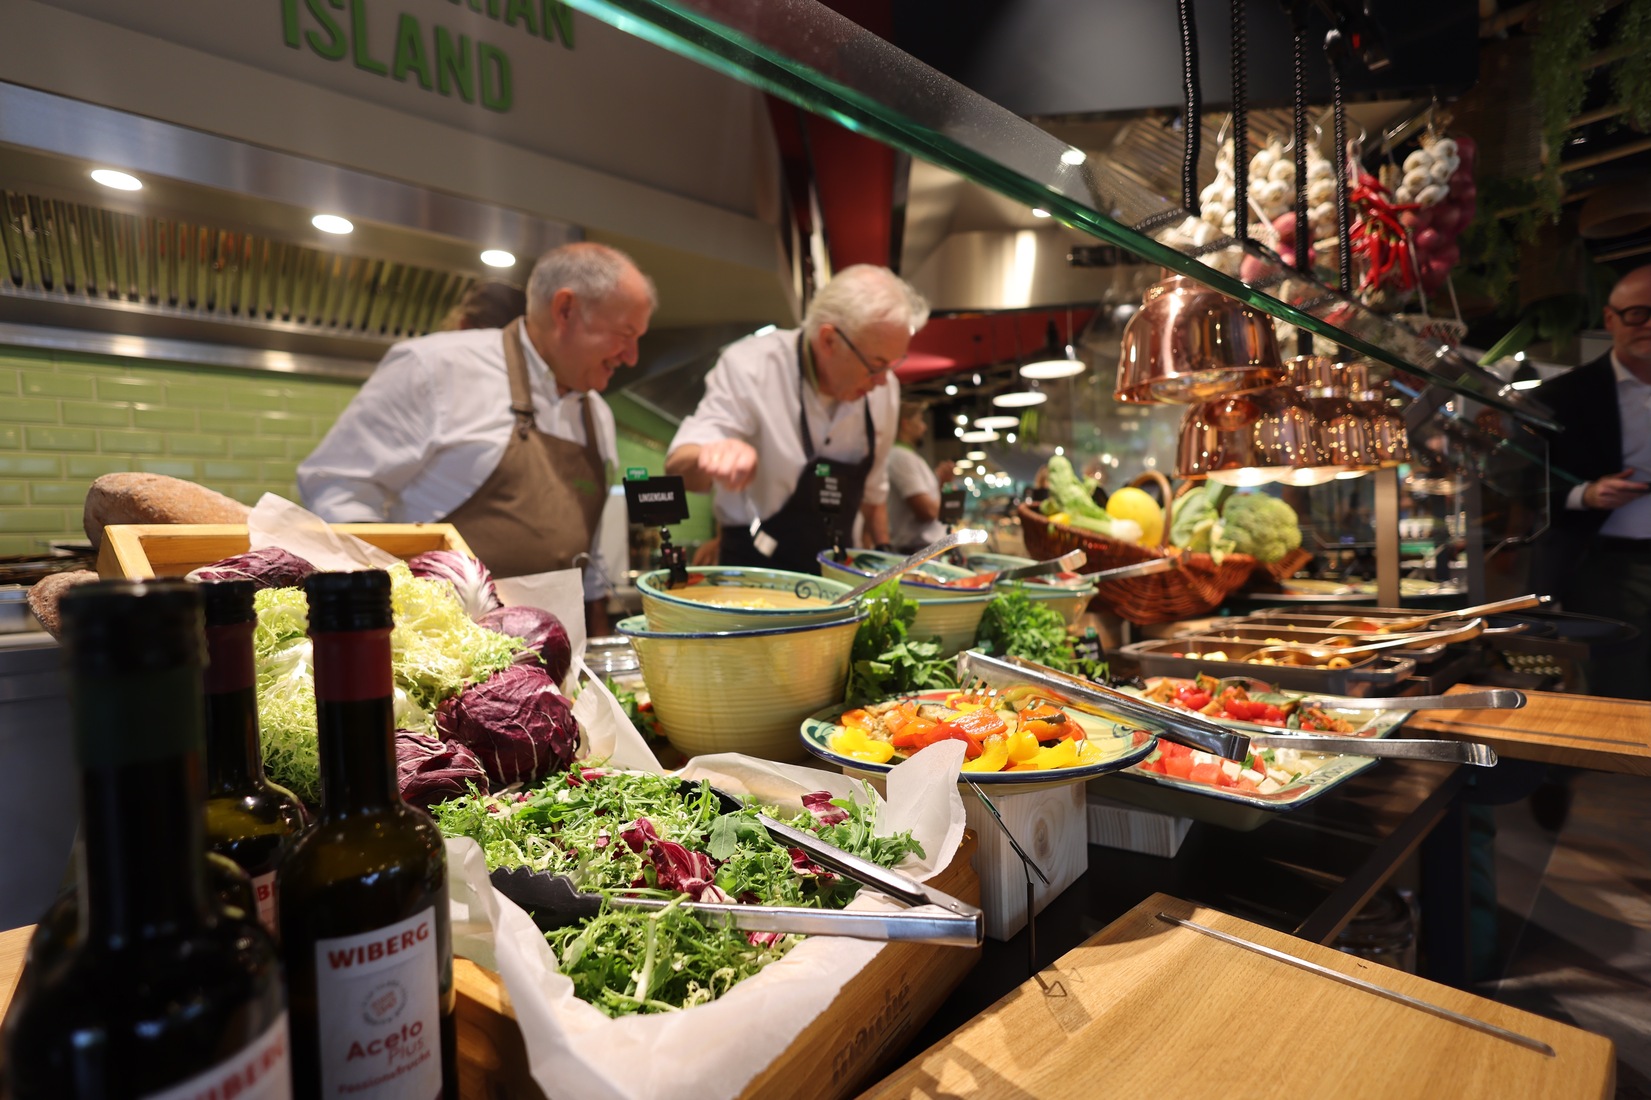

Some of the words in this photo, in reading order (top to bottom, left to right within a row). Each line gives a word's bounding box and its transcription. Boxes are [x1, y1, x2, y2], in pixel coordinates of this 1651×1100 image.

[281, 0, 514, 112] ISLAND
[638, 491, 675, 503] LINSENSALAT
[328, 922, 429, 970] WIBERG
[346, 1020, 424, 1063] Aceto
